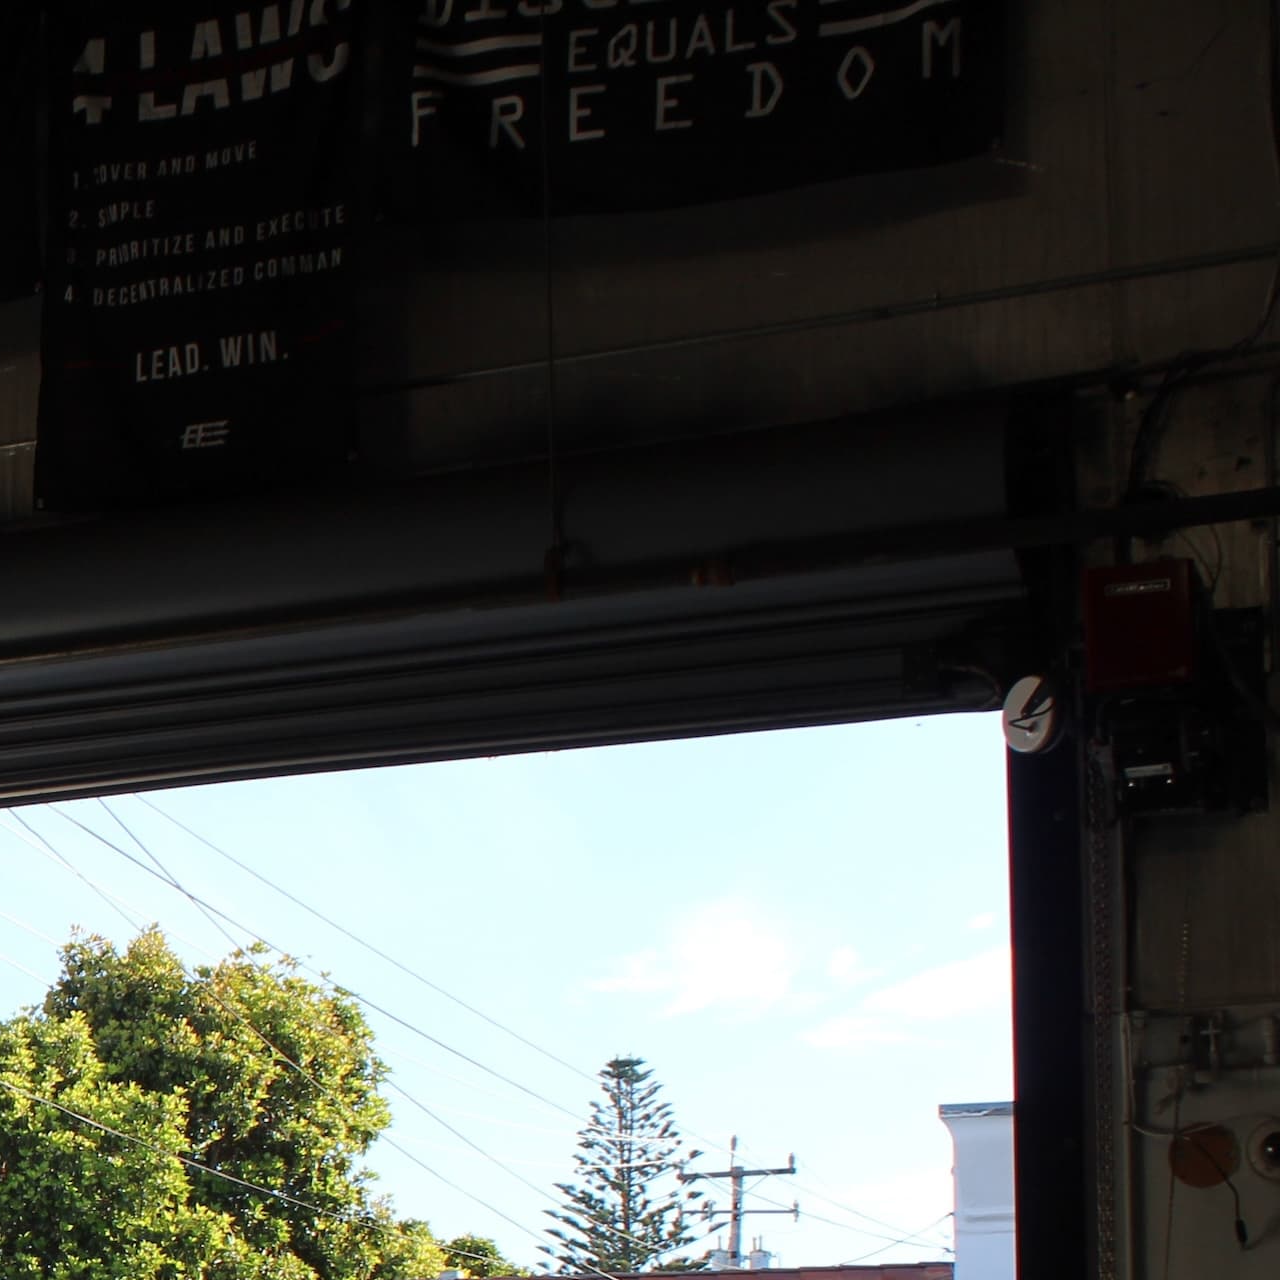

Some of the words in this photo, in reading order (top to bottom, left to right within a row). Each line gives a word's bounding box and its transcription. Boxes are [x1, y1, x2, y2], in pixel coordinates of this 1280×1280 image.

[72, 37, 113, 124] 4
[137, 0, 352, 123] LAWS
[567, 0, 798, 73] EQUALS
[410, 16, 962, 148] FREEDOM
[157, 153, 197, 178] AND
[205, 139, 258, 170] MOVE
[204, 225, 246, 250] AND
[255, 203, 346, 242] EXECUTE
[92, 265, 246, 307] DECENTRALIZED
[253, 247, 344, 281] COMMAN
[135, 341, 209, 384] LEAD.
[219, 330, 290, 369] WIN.
